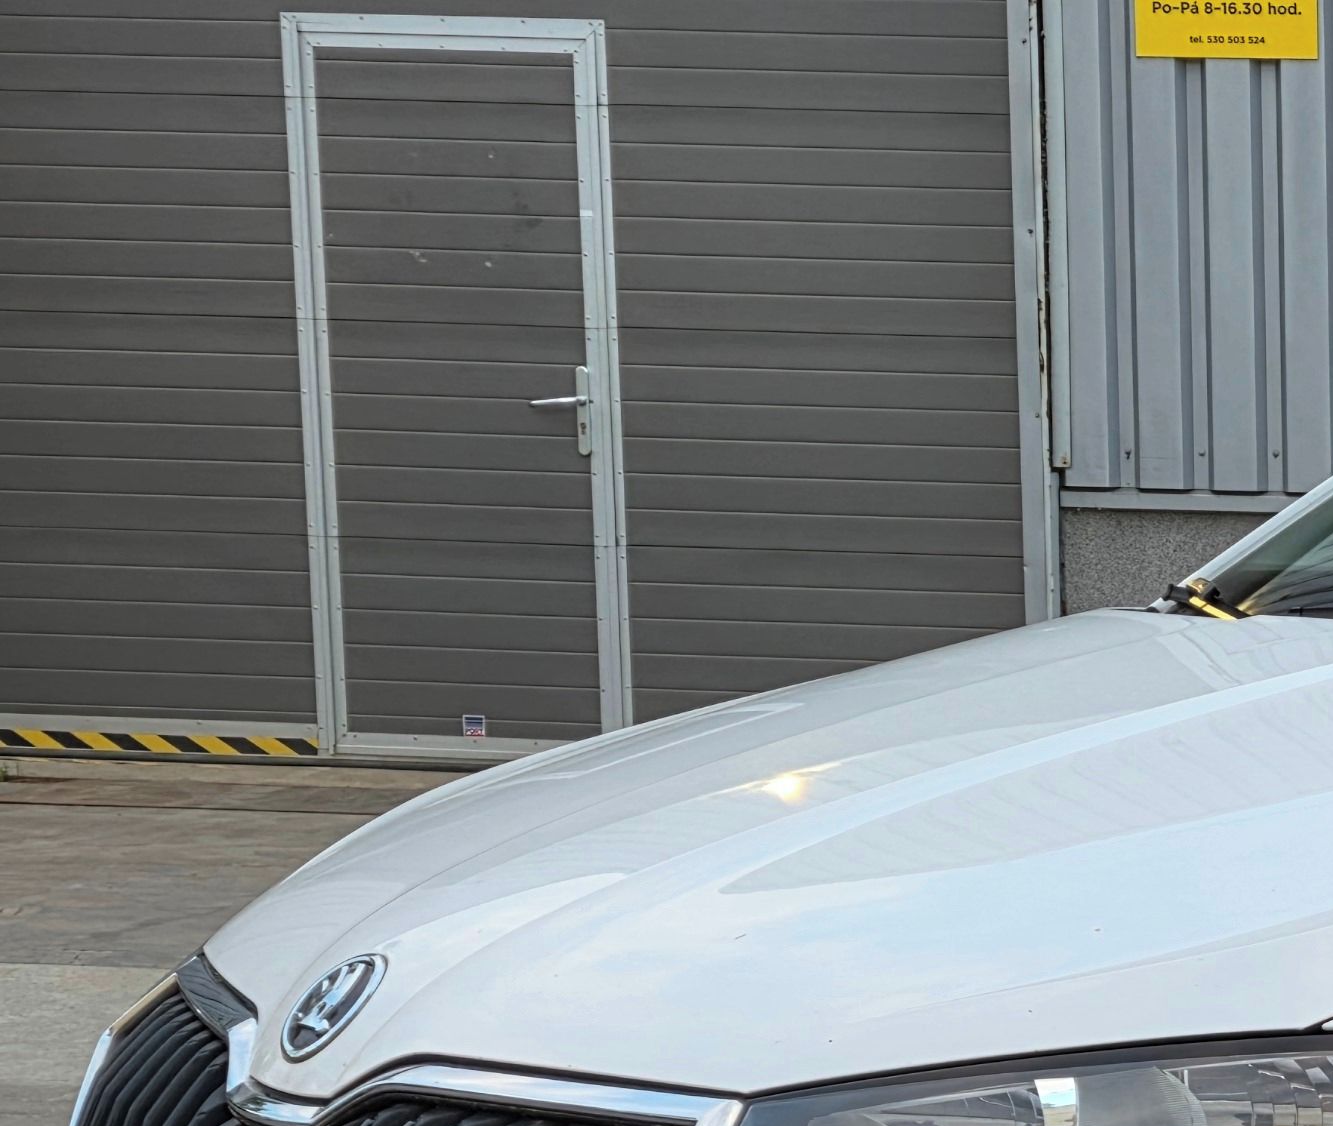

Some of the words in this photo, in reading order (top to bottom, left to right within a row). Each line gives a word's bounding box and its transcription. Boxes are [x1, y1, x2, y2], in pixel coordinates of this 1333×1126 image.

[1152, 1, 1199, 15] Po-Pá
[1204, 2, 1263, 15] 8-16.30
[1267, 2, 1302, 15] hod.
[1189, 35, 1204, 43] tel.
[1207, 36, 1225, 44] 530
[1227, 36, 1245, 44] 503
[1248, 36, 1265, 44] 524
